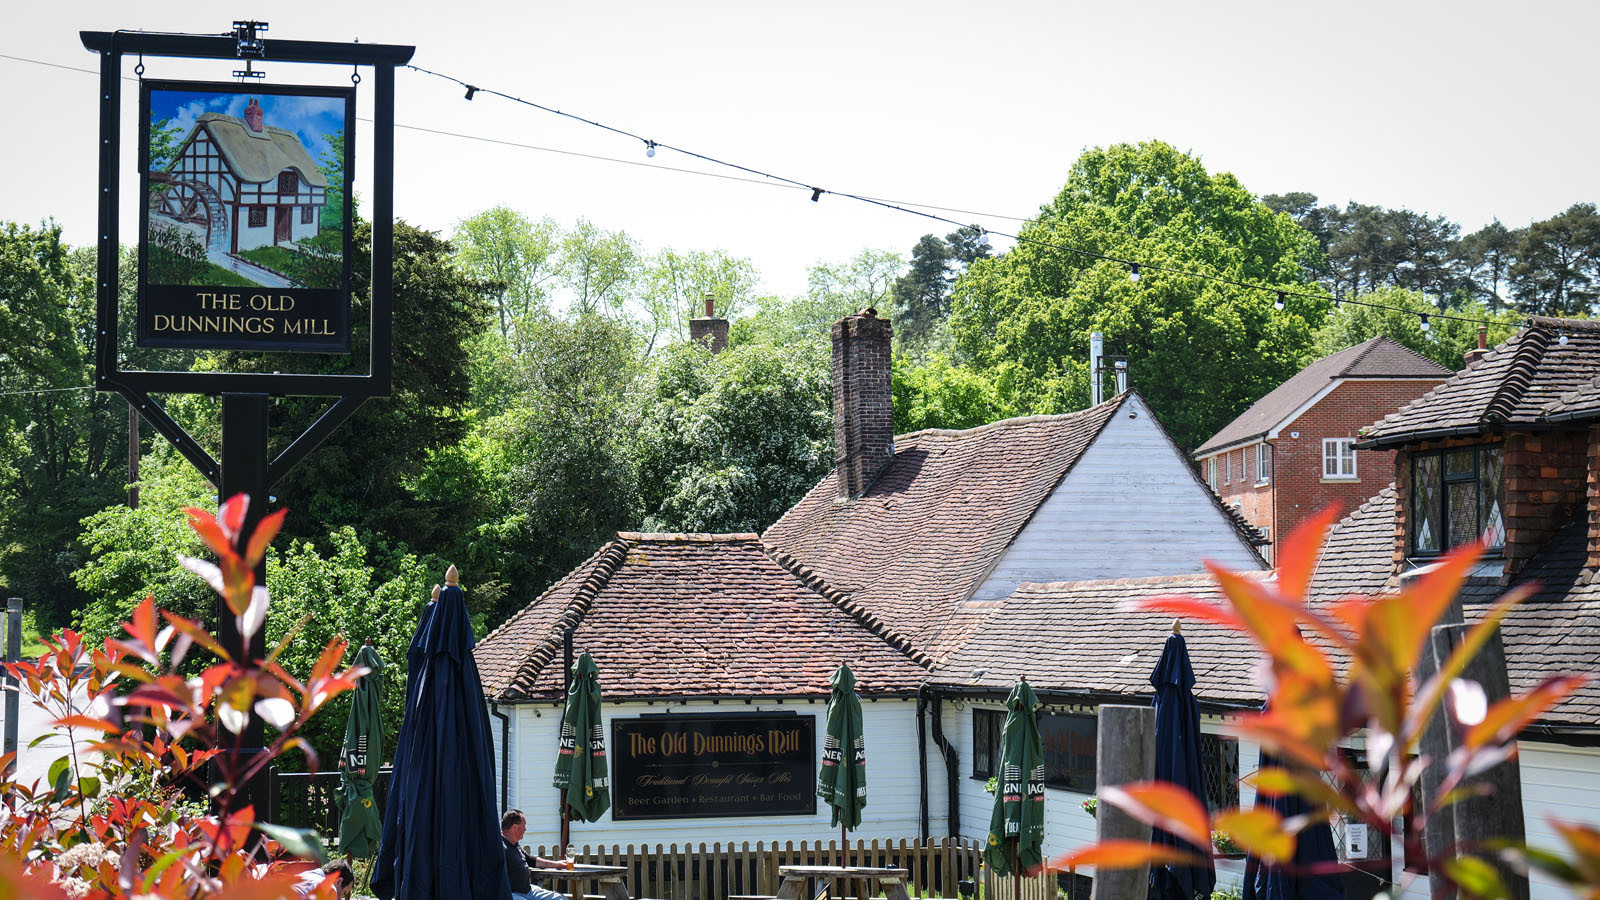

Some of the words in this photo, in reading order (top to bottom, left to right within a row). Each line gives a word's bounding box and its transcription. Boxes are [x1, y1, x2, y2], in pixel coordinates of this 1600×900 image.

[196, 293, 241, 310] THE
[249, 294, 295, 312] OLD
[153, 314, 275, 334] DUNNINGS
[284, 318, 336, 335] MILL
[628, 732, 656, 758] The
[660, 731, 687, 756] Old
[693, 731, 764, 756] Dunnings
[768, 729, 800, 755] Mill
[636, 774, 690, 788] Traditional
[692, 773, 735, 788] Draught
[628, 797, 649, 806] Beer
[653, 795, 689, 805] Garden
[698, 794, 749, 804] Restaurant
[759, 793, 775, 802] Bar
[778, 792, 801, 801] Food
